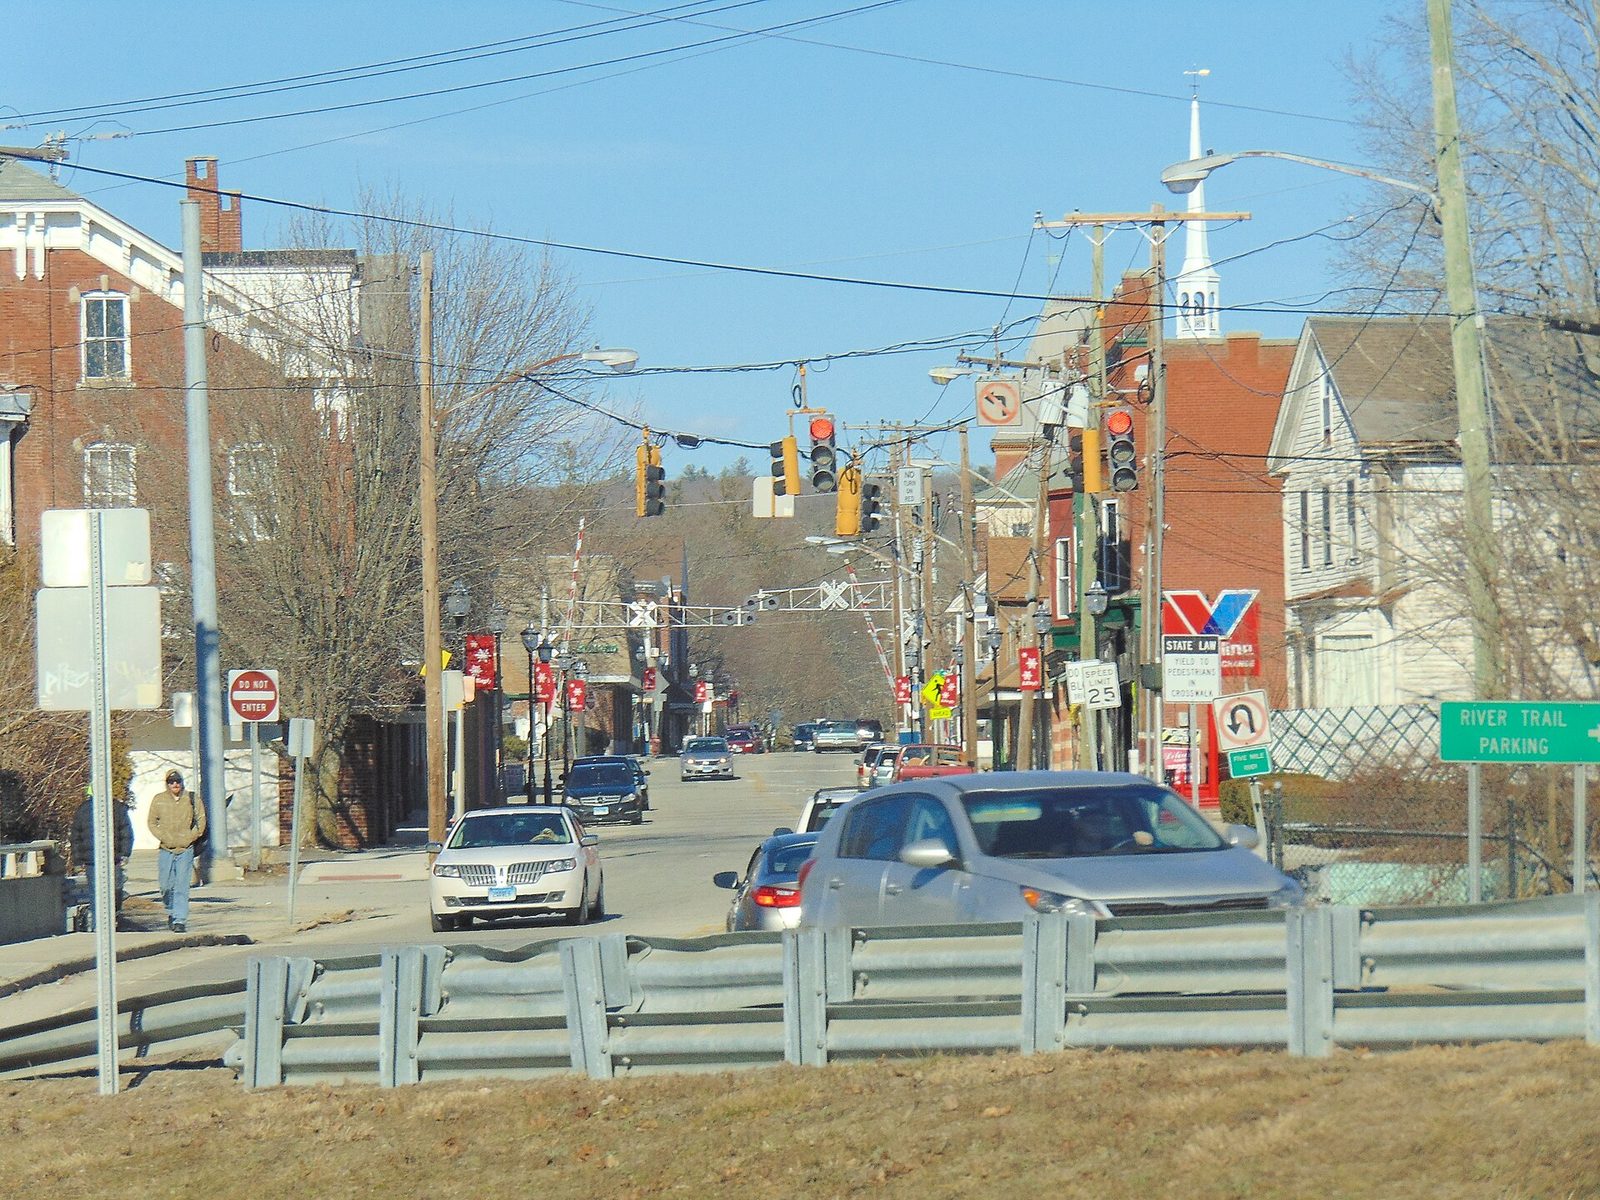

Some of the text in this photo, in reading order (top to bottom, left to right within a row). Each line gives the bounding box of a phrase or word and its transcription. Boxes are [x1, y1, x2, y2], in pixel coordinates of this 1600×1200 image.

[1166, 640, 1217, 651] STATE LAW
[1175, 657, 1210, 666] YIELD TO
[1085, 669, 1114, 679] SPEED
[1168, 668, 1216, 677] PEDESTRIANS
[239, 680, 269, 689] DO NOT
[1089, 677, 1112, 687] LIMIT
[1088, 686, 1115, 704] 25
[1171, 689, 1214, 698] CROSSWALK
[241, 703, 267, 712] ENTER
[1460, 709, 1568, 728] RIVER TRAIL
[1479, 737, 1549, 755] PARKING
